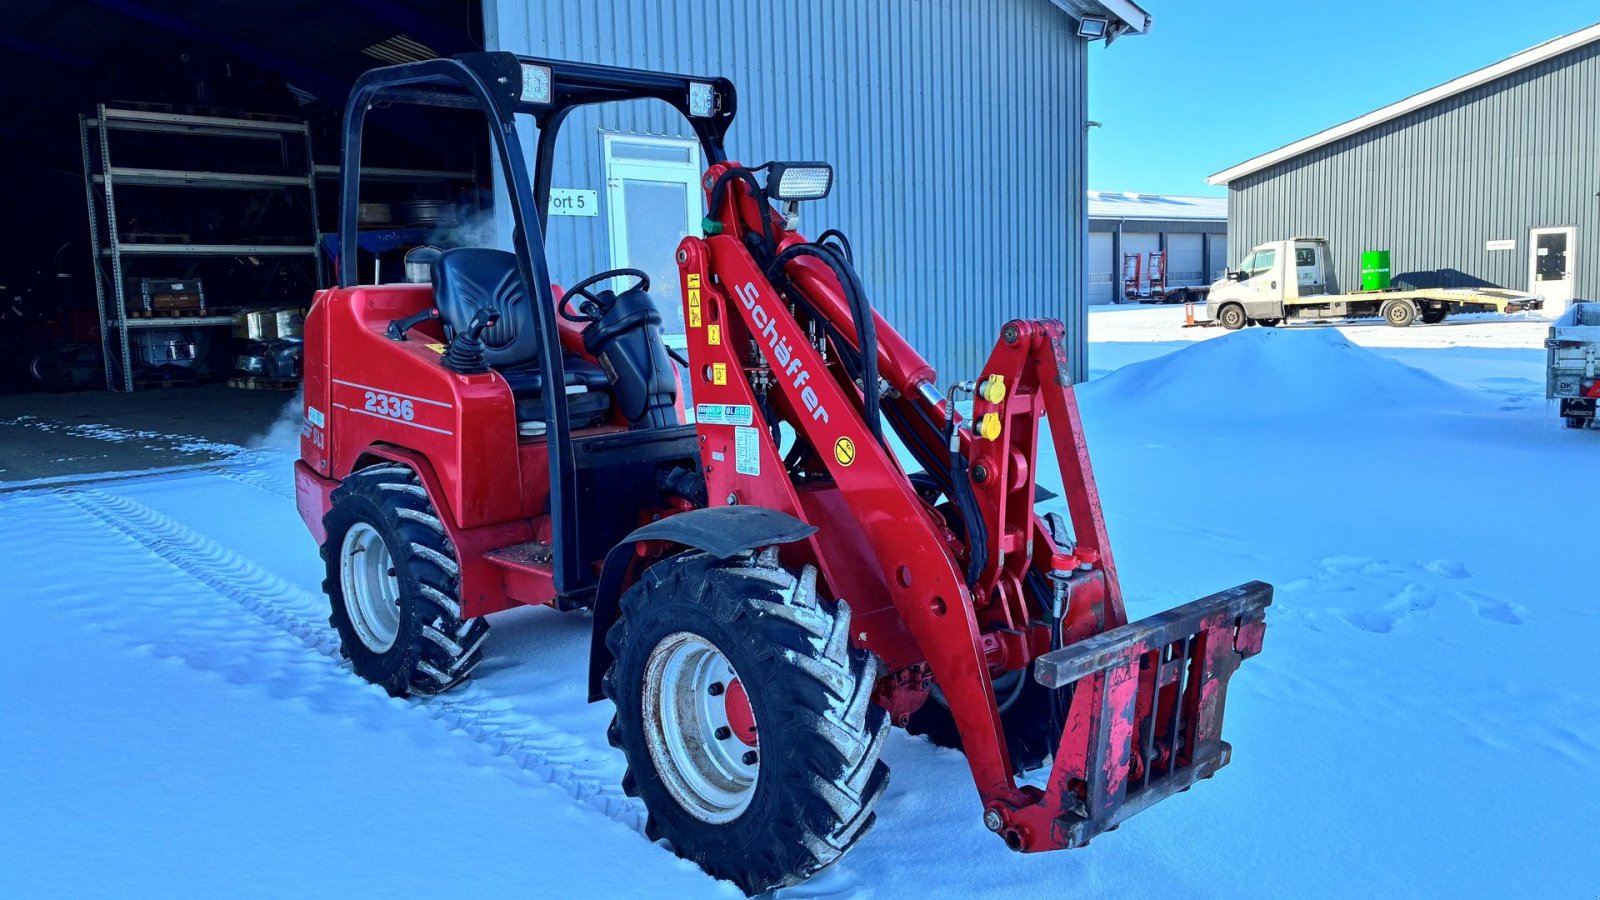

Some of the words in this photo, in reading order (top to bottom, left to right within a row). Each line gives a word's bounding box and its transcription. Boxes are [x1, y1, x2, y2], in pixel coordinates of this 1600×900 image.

[577, 195, 585, 208] 5
[735, 282, 829, 424] Schäffer
[365, 391, 414, 421] 2336
